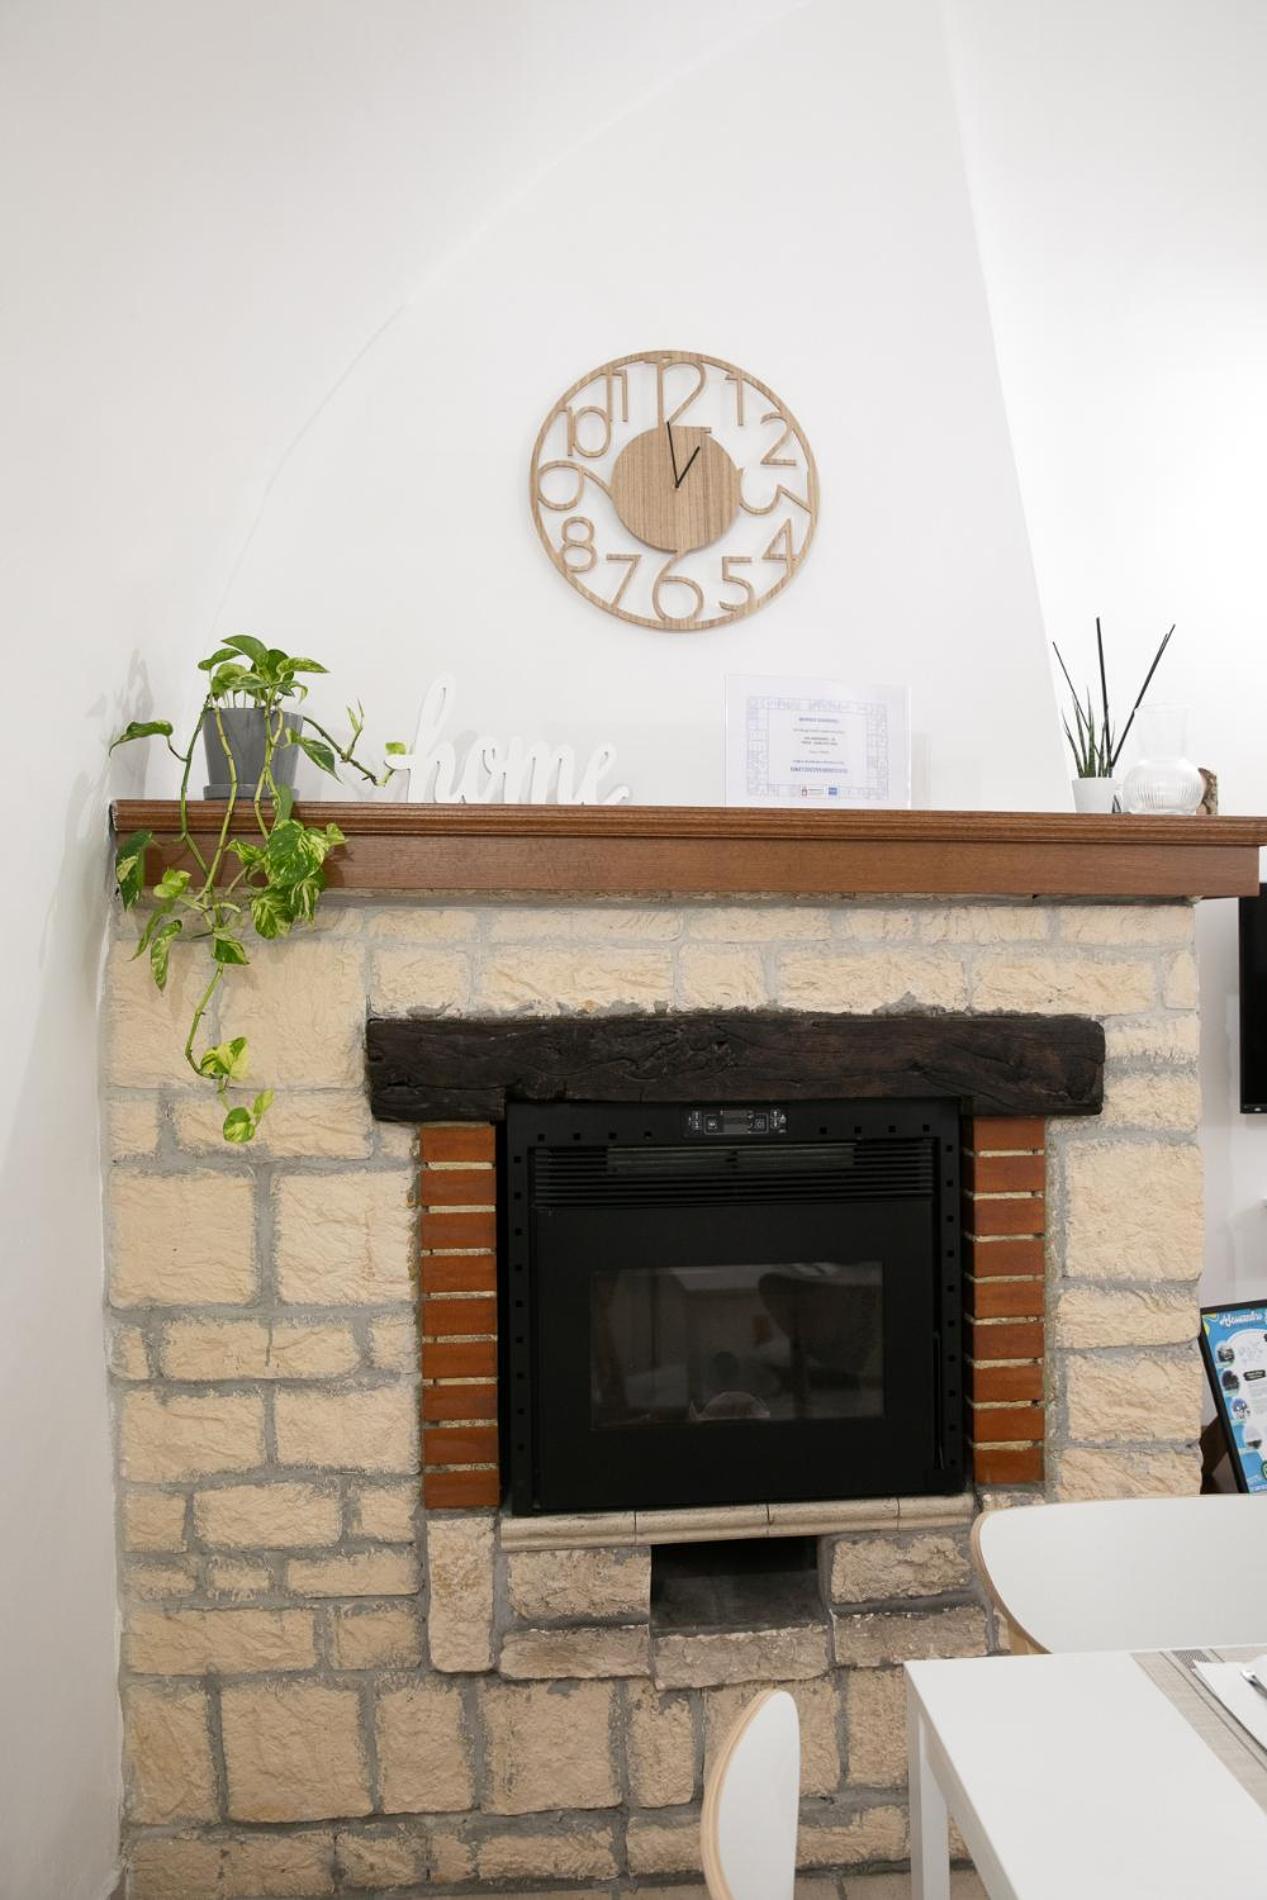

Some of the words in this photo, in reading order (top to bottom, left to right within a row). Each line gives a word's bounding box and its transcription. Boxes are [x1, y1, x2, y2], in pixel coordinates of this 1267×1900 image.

[599, 366, 628, 422] 11
[643, 358, 712, 433] 12
[724, 371, 744, 426] 1
[557, 405, 612, 457] 10
[760, 411, 797, 466] 2
[537, 460, 614, 511] 9
[736, 467, 814, 515] 3
[560, 517, 597, 572] 8
[762, 519, 796, 576] 4
[606, 554, 642, 609] 7
[652, 550, 704, 622] 6
[720, 556, 755, 611] 5
[408, 672, 631, 804] home
